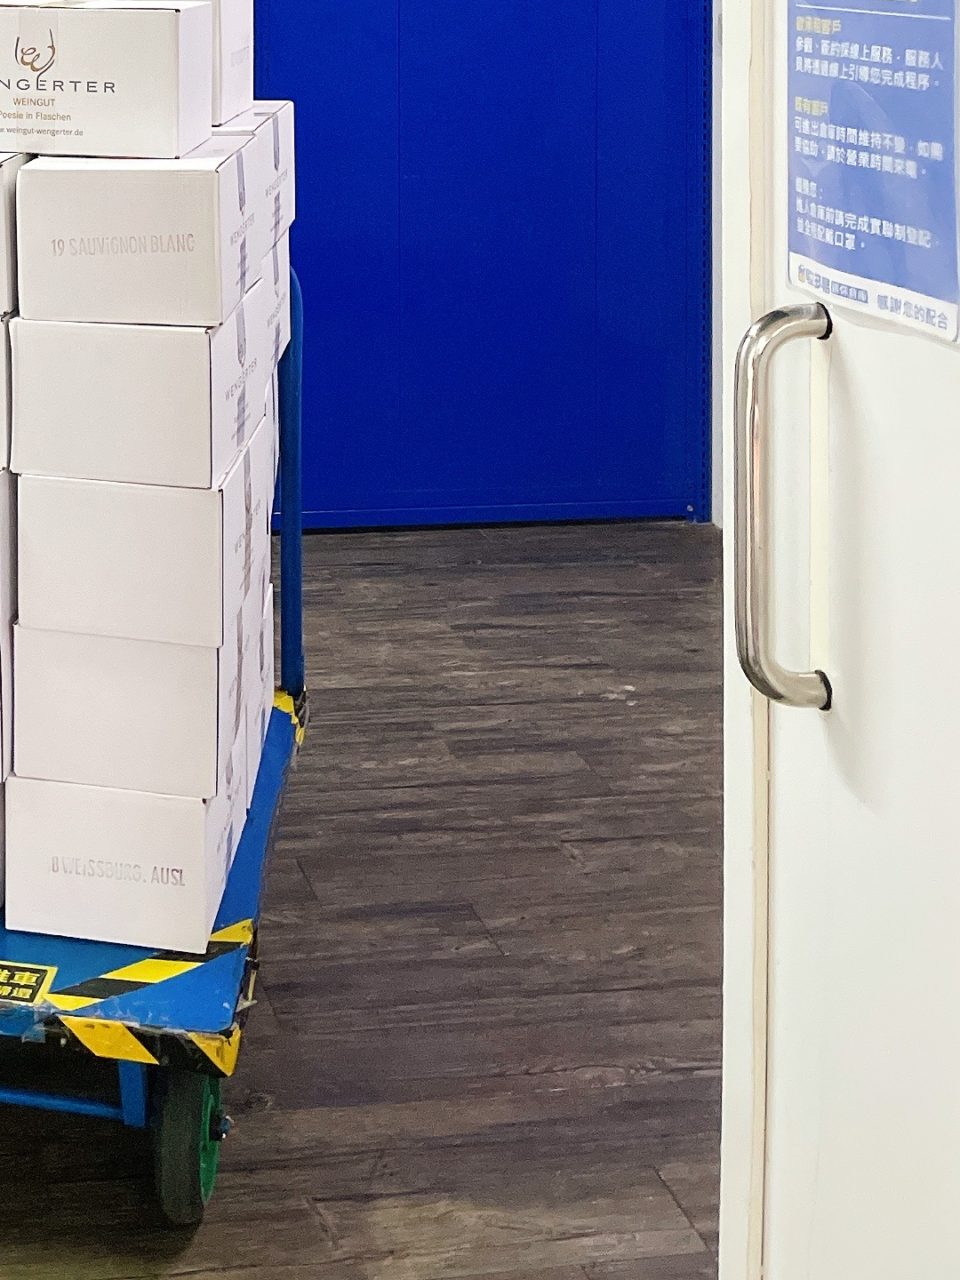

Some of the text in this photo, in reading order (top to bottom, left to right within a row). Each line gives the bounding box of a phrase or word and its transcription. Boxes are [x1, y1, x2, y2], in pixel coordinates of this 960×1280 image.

[13, 97, 56, 108] WEINGUT
[25, 111, 34, 121] in
[35, 111, 72, 122] Flaschen
[50, 239, 65, 258] 19
[69, 235, 147, 258] SAUVIGNON
[151, 865, 186, 887] AUSL
